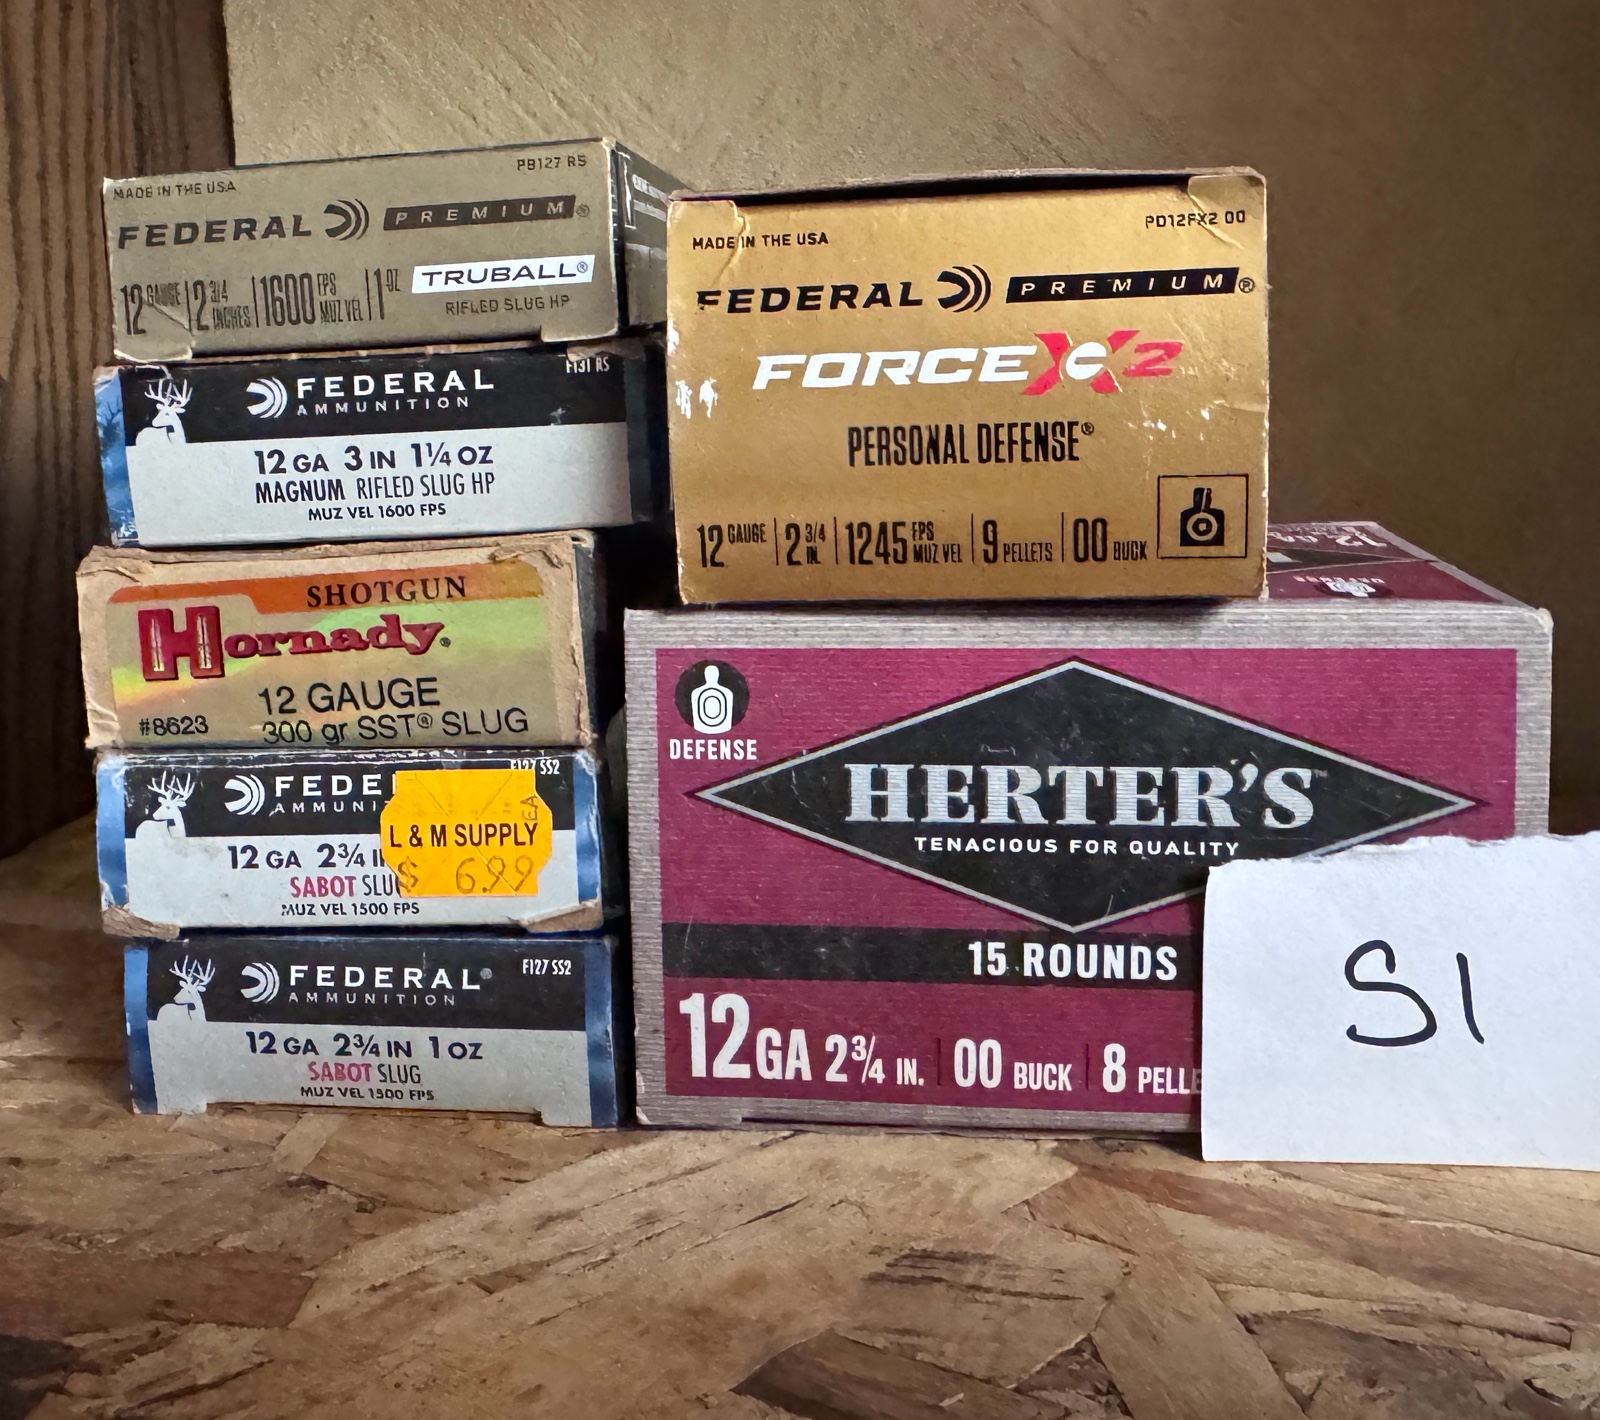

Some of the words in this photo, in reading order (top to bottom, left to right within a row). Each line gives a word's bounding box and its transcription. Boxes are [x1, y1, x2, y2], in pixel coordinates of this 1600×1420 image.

[517, 156, 562, 171] PB127
[566, 154, 588, 167] RS
[113, 186, 153, 200] MADE
[157, 185, 171, 197] IN
[175, 183, 203, 196] THE
[206, 181, 237, 194] USA
[117, 214, 312, 250] FEDERAL
[1145, 212, 1218, 229] PD12FX2
[692, 236, 736, 250] MADE
[741, 235, 755, 248] IN
[761, 233, 792, 247] THE
[796, 231, 829, 246] USA
[316, 272, 337, 297] FPS
[385, 268, 401, 293] OZ
[146, 282, 181, 306] GAUGE
[192, 279, 210, 332] 2
[259, 272, 316, 327] 1600
[373, 267, 385, 321] 1
[445, 299, 499, 316] RIFLED
[504, 297, 545, 312] SLUG
[550, 295, 570, 309] HP
[696, 280, 924, 314] FEDERAL
[120, 283, 147, 336] 12
[213, 305, 251, 330] INCHES
[319, 299, 344, 325] MUZ
[345, 298, 364, 323] VEL
[595, 355, 610, 372] RS
[296, 368, 495, 399] FEDERAL
[296, 396, 469, 416] AMMUNITION
[847, 423, 970, 468] PERSONAL
[254, 449, 287, 475] 12
[292, 453, 330, 473] GA
[343, 445, 363, 472] 3
[369, 450, 396, 470] IN
[457, 445, 494, 466] OZ
[255, 478, 347, 504] MAGNUM
[356, 475, 414, 500] RIFLED
[420, 472, 465, 497] SLUG
[471, 472, 496, 495] HP
[308, 507, 344, 521] MUZ
[346, 505, 374, 519] VEL
[378, 504, 415, 518] 1600
[420, 503, 447, 516] FPS
[727, 522, 767, 545] GAUGE
[785, 522, 803, 566] 2
[844, 521, 908, 566] 1245
[911, 520, 935, 543] FPS
[981, 519, 998, 564] 9
[696, 522, 725, 568] 12
[912, 543, 940, 565] MUZ
[942, 542, 964, 564] VEL
[1003, 541, 1053, 563] PELLETS
[1112, 540, 1148, 562] BUCK
[306, 575, 467, 608] SHOTGUN
[138, 604, 446, 683] Hornady
[258, 685, 298, 715] 12
[306, 676, 441, 713] GAUGE
[139, 714, 209, 737] #8623
[261, 719, 313, 745] 300
[320, 721, 348, 746] gr
[441, 706, 529, 737] SLUG
[669, 738, 758, 761] DEFENSE
[540, 758, 561, 775] SS2
[389, 824, 403, 848] L
[408, 823, 424, 849] &
[430, 823, 447, 847] M
[453, 821, 539, 848] SUPPLY
[914, 835, 1059, 855] TENACIOUS
[1069, 837, 1118, 855] FOR
[1128, 838, 1241, 858] QUALITY
[227, 844, 260, 870] 12
[265, 850, 302, 870] GA
[289, 875, 357, 898] SABOT
[455, 854, 535, 895] 6.99
[281, 903, 316, 917] MUZ
[319, 902, 347, 916] VEL
[351, 902, 389, 916] 1500
[393, 902, 420, 916] FPS
[522, 958, 549, 976] F127
[551, 958, 572, 976] SS2
[967, 940, 1007, 977] 15
[1022, 941, 1179, 982] ROUNDS
[289, 964, 481, 990] FEDERAL
[288, 992, 455, 1006] AMMUNITION
[245, 1030, 278, 1055] 12
[283, 1036, 320, 1056] GA
[386, 1040, 413, 1059] IN
[428, 1035, 440, 1059] 1
[447, 1041, 484, 1060] OZ
[678, 991, 751, 1079] 12
[755, 1027, 813, 1082] GA
[895, 1056, 926, 1087] IN.
[953, 1037, 1003, 1090] 00
[1012, 1061, 1073, 1093] BUCK
[1101, 1042, 1127, 1094] 8
[307, 1060, 372, 1083] SABOT
[377, 1063, 422, 1085] SLUG
[300, 1086, 335, 1098] MUZ
[337, 1087, 365, 1099] VEL
[409, 1089, 435, 1101] FPS
